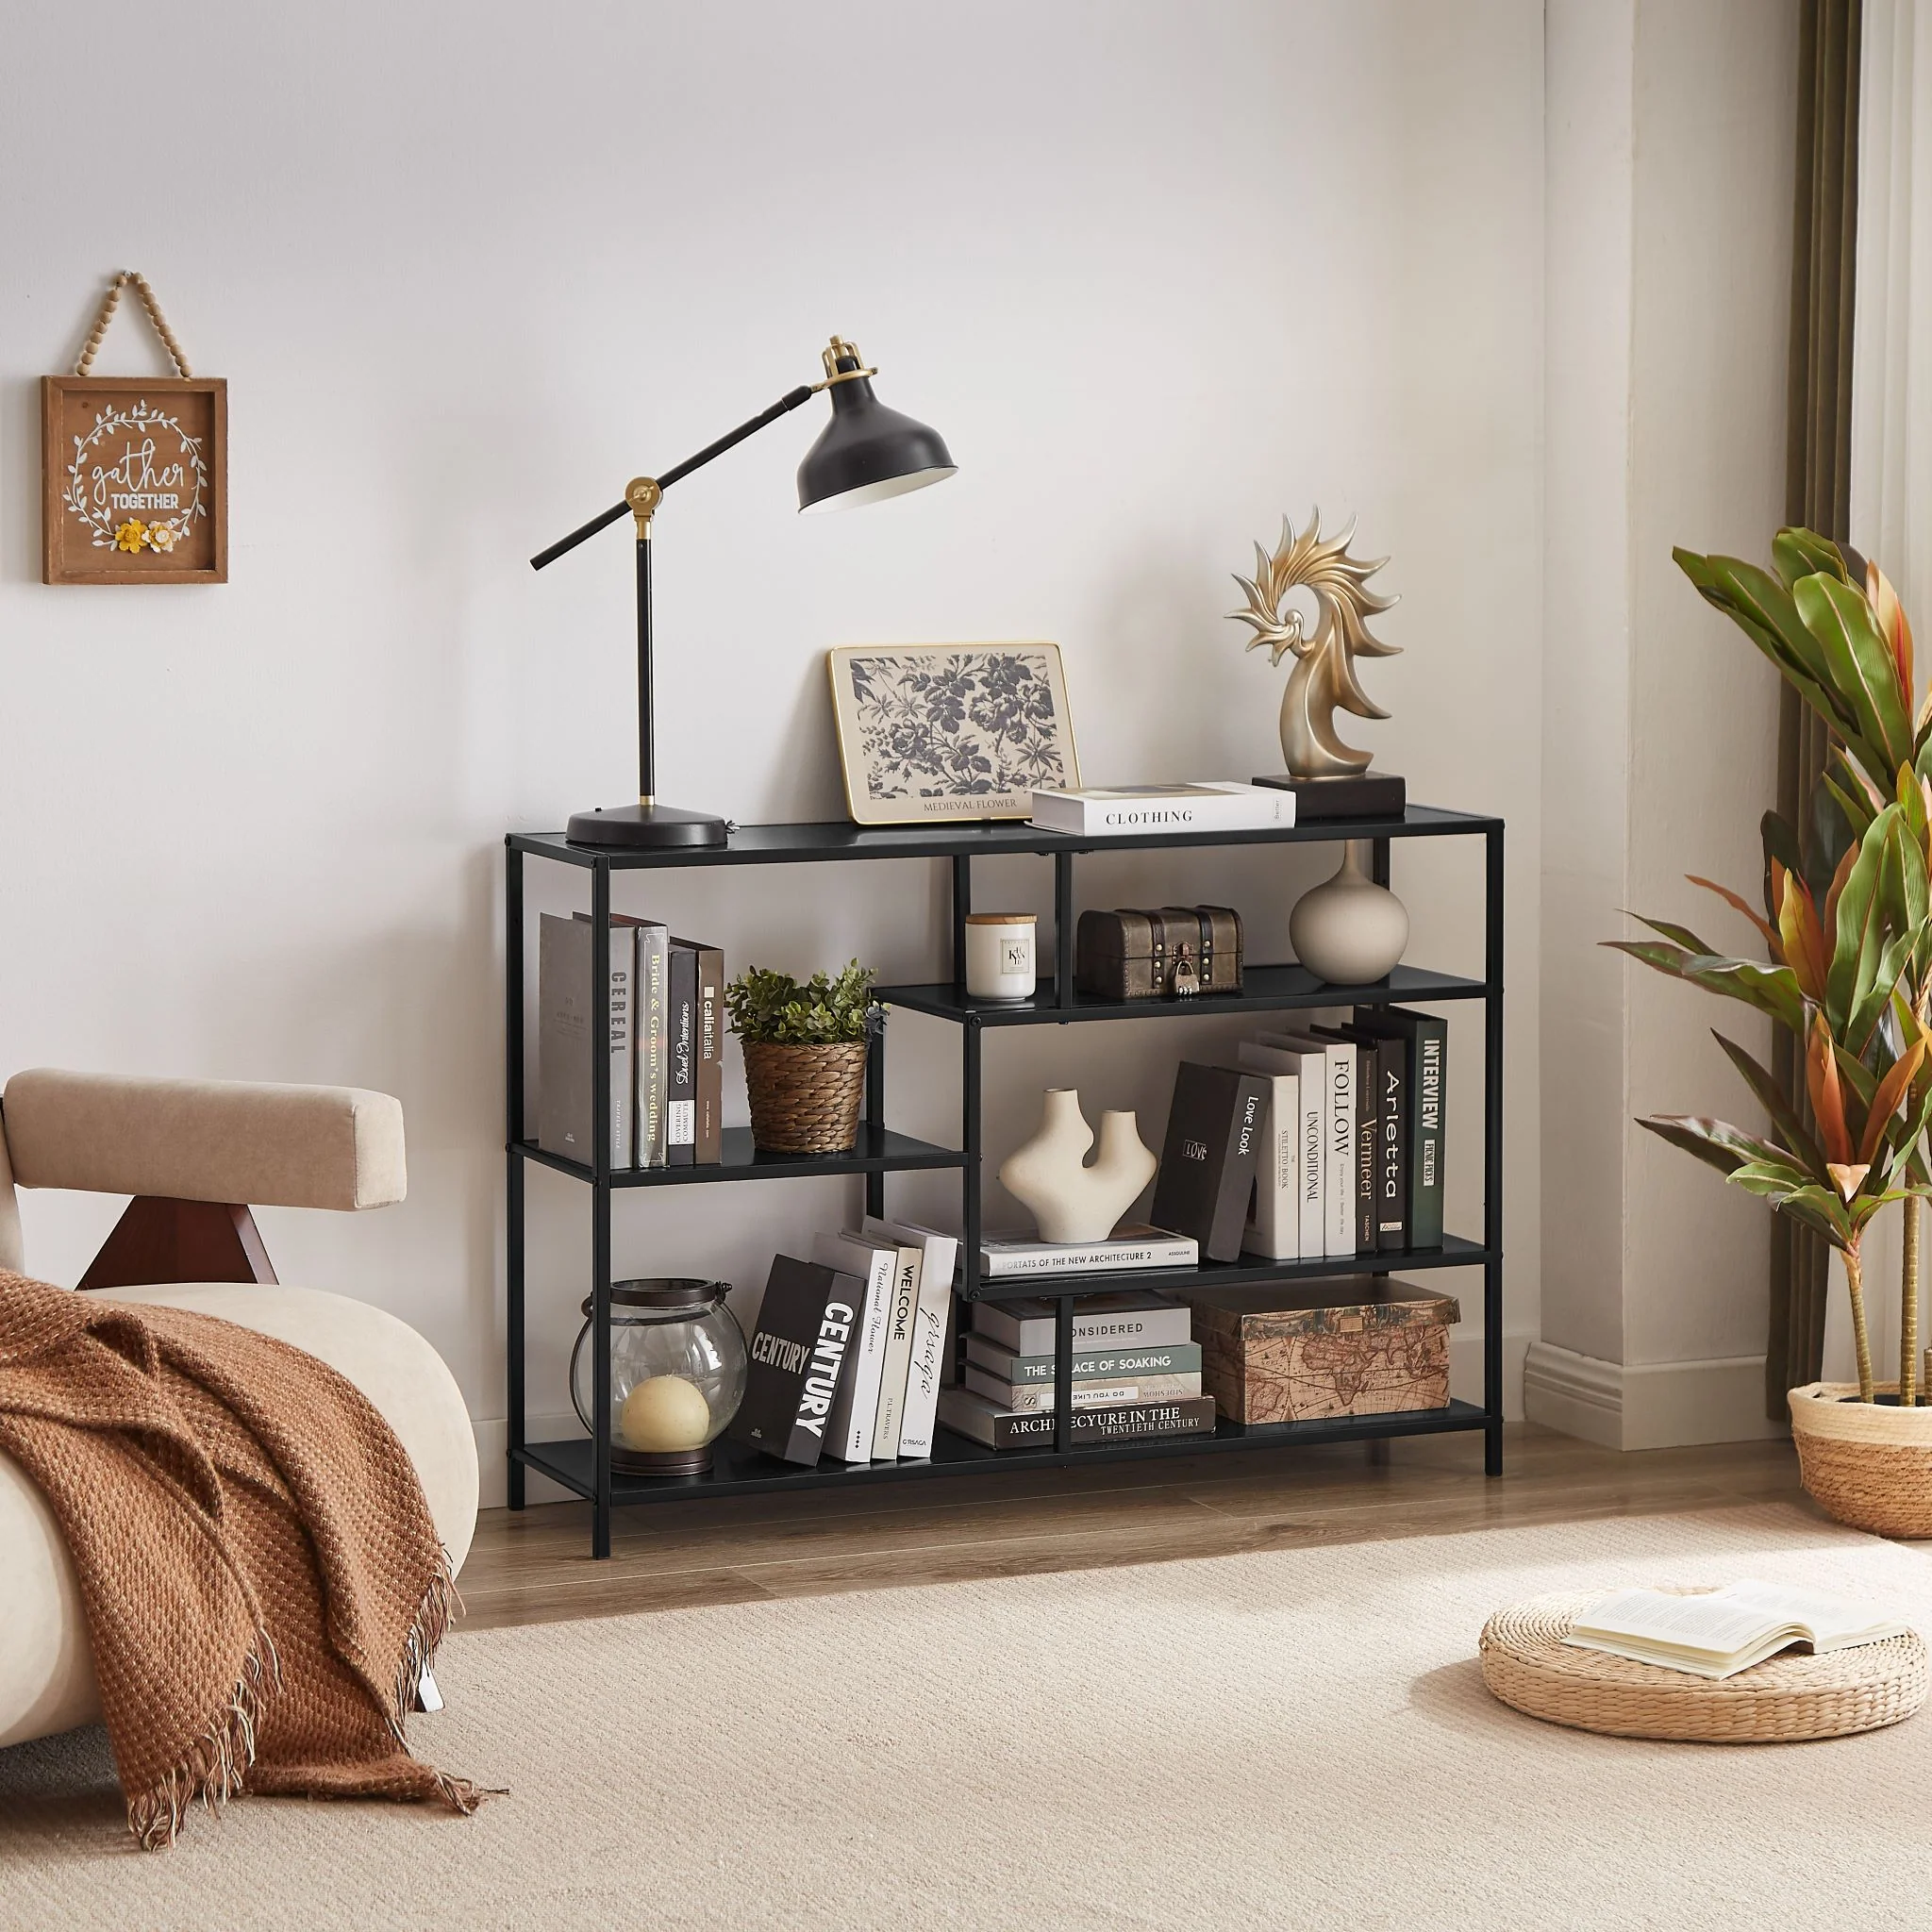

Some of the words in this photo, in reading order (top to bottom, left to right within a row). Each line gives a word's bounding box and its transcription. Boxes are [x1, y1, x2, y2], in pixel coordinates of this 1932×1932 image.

[92, 438, 185, 505] gather
[110, 492, 179, 509] TOGETHER
[924, 800, 974, 812] MEDIEVAL
[975, 798, 1018, 809] FLOWER
[1105, 809, 1193, 825] CLOTHING
[650, 954, 660, 994] Bride
[611, 972, 626, 1054] CEREAL
[651, 997, 660, 1011] &
[649, 1015, 659, 1079] Groom's
[704, 1001, 714, 1059] caliaitalia
[1423, 1039, 1441, 1129] INTERVIEW
[646, 1084, 658, 1141] wedding
[1243, 1096, 1259, 1125] Love
[1334, 1059, 1350, 1156] FOLLOW
[1238, 1125, 1254, 1156] Look
[1385, 1071, 1400, 1198] Arletta
[1307, 1111, 1319, 1203] UNCONDITIONAL
[1360, 1118, 1377, 1200] Vermeer
[1039, 1258, 1050, 1267] OF
[1052, 1257, 1066, 1266] THE
[1068, 1256, 1087, 1265] NEW
[1089, 1252, 1144, 1264] ARCHITECTURE
[1146, 1251, 1152, 1259] 2
[873, 1262, 889, 1313] National
[893, 1264, 915, 1341] WELCOME
[867, 1315, 882, 1357] Flower
[1072, 1323, 1143, 1338] ONSIDERED
[752, 1331, 811, 1374] CENTURY
[795, 1302, 854, 1439] CENTURY
[1024, 1364, 1047, 1377] THE
[1051, 1360, 1095, 1375] SACE
[1099, 1359, 1115, 1372] OF
[1119, 1355, 1172, 1370] SOAKING
[1073, 1392, 1091, 1401] LIKE
[1130, 1409, 1147, 1424] IN
[1149, 1407, 1180, 1422] THE
[1100, 1422, 1155, 1435] TWENTIETH
[1158, 1417, 1200, 1430] CENTURY
